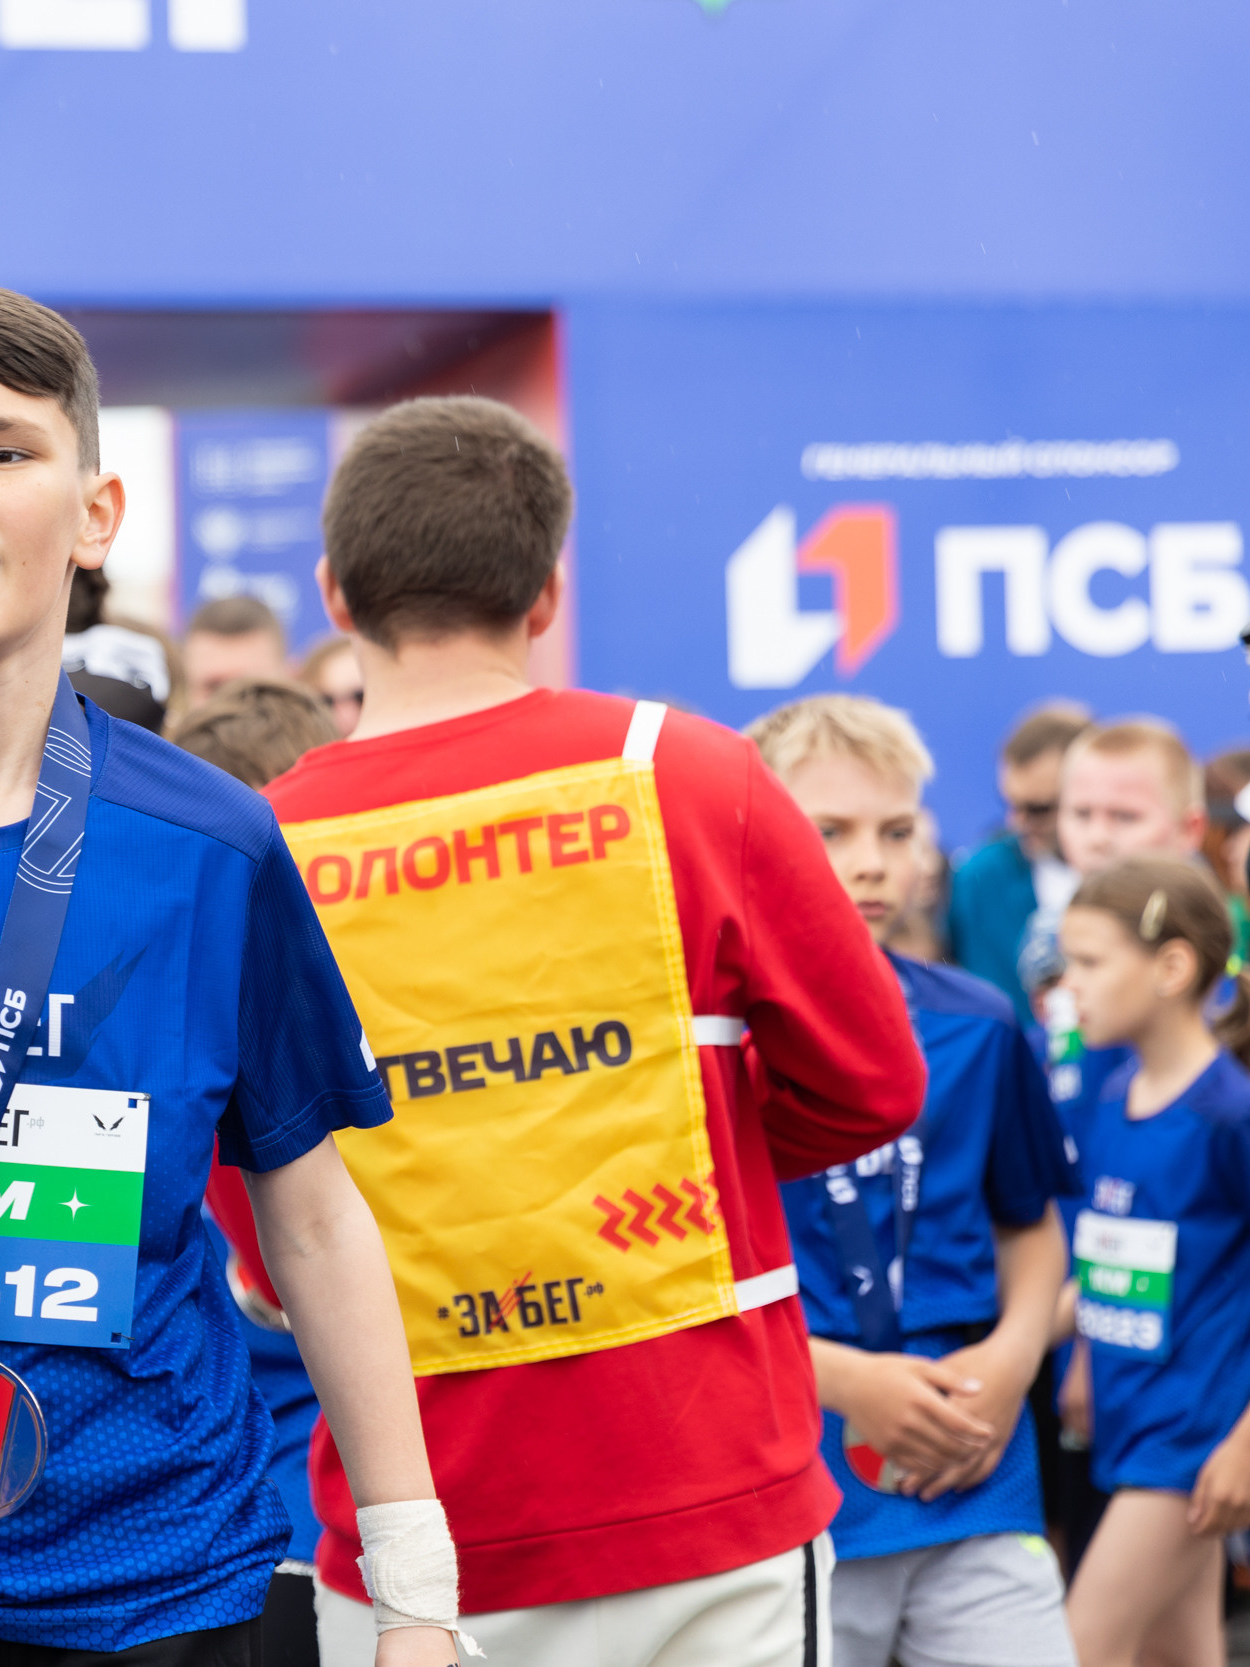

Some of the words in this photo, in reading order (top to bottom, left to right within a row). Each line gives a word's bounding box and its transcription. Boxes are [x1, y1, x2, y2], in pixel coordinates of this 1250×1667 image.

[934, 519, 1250, 659] ПСБ
[297, 804, 631, 906] ОЛОНТЕР
[374, 1020, 632, 1101] ТВЕЧАЮ
